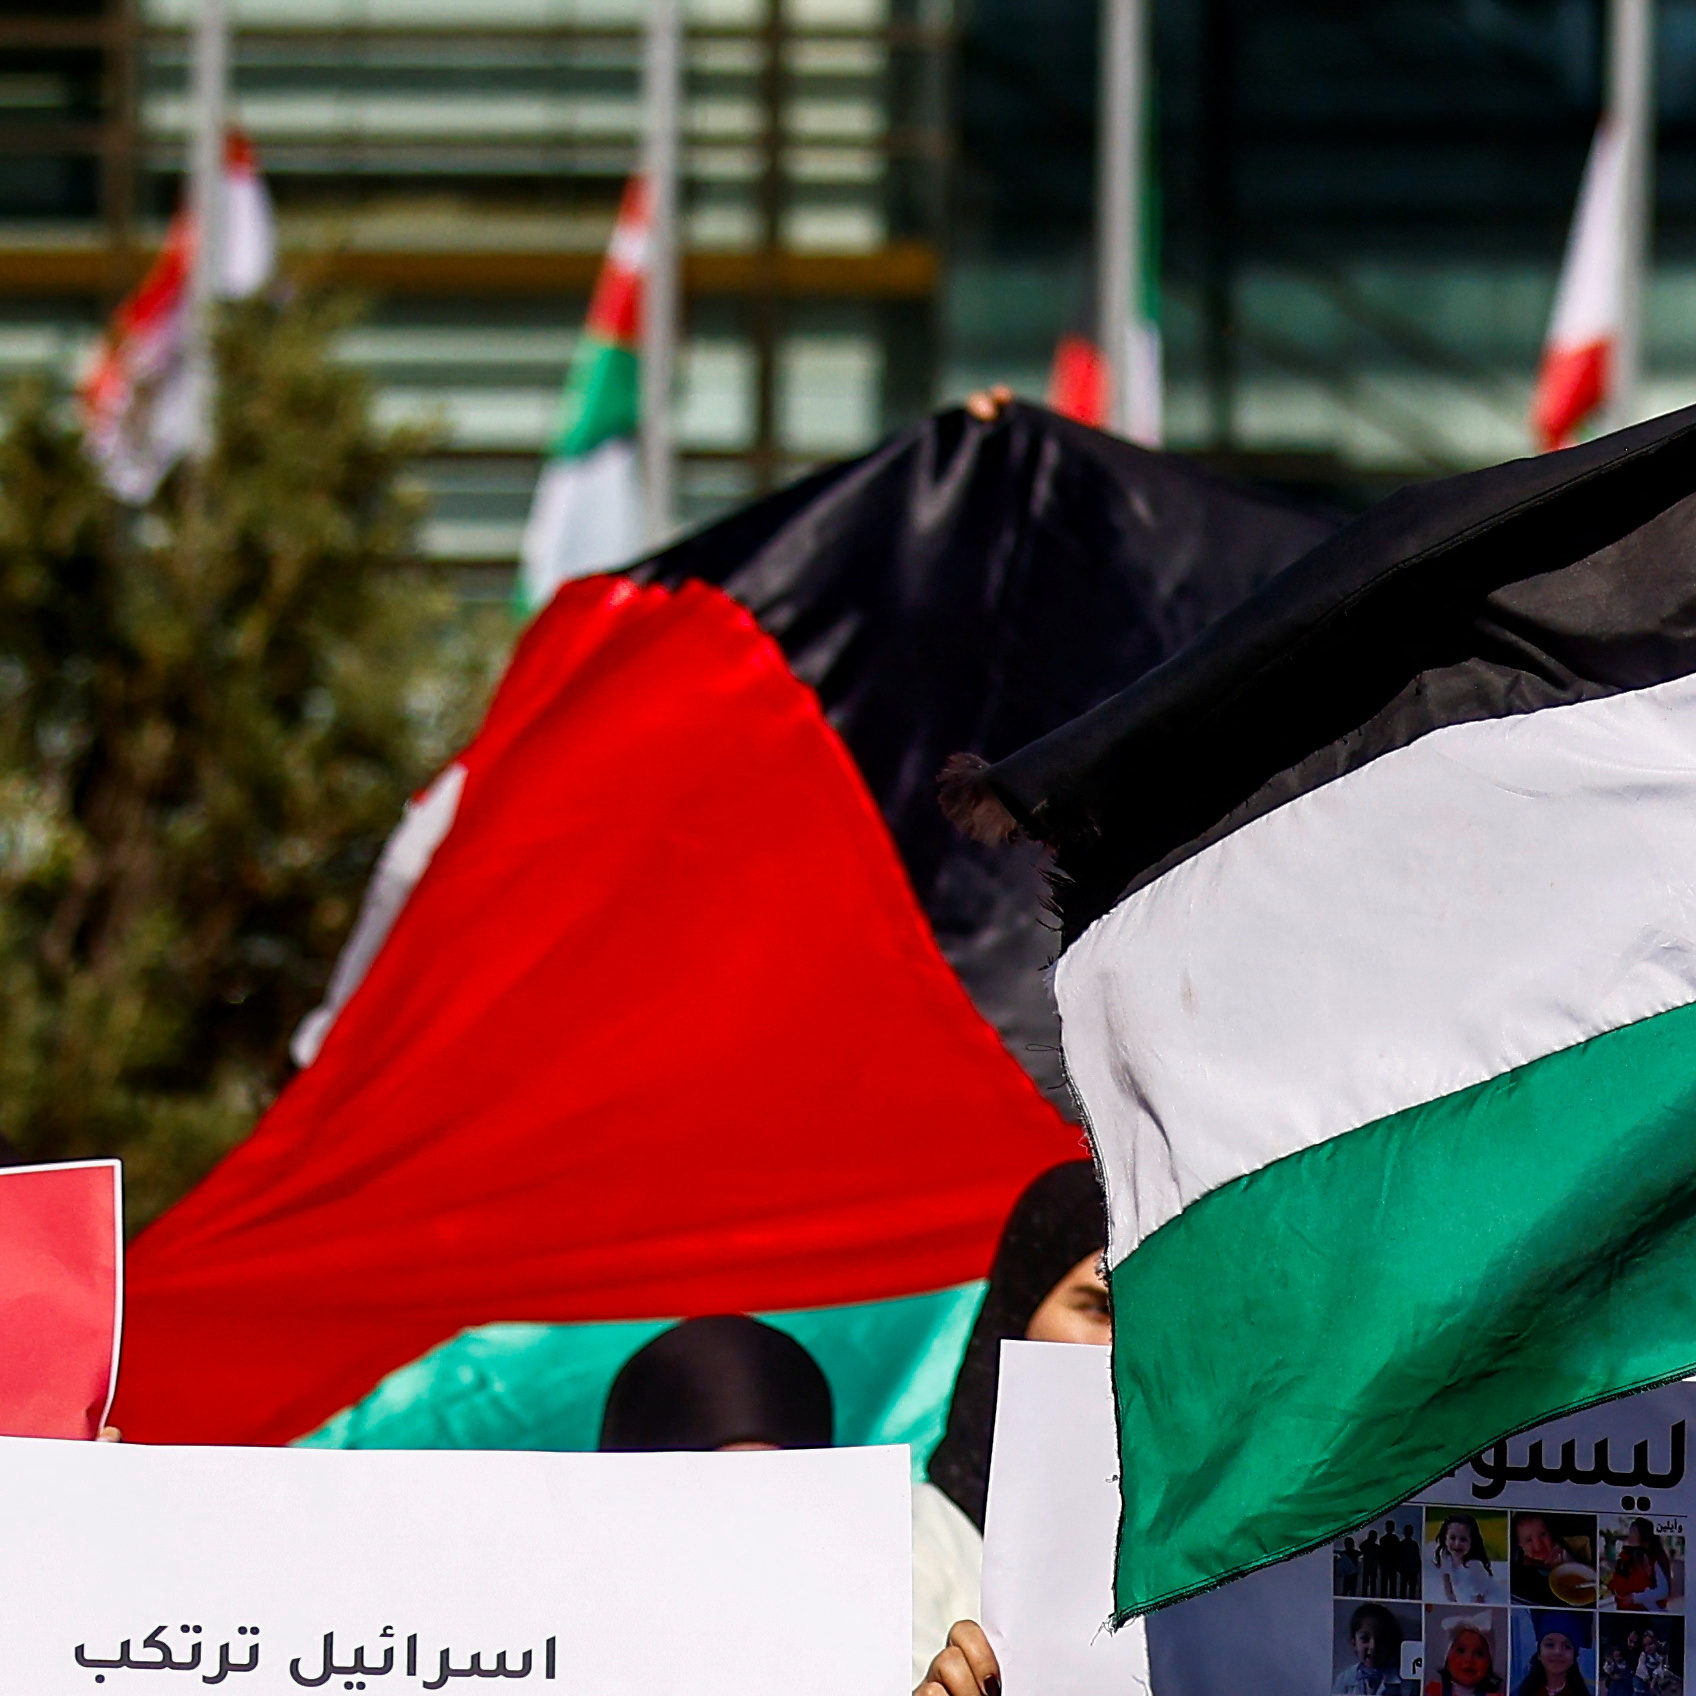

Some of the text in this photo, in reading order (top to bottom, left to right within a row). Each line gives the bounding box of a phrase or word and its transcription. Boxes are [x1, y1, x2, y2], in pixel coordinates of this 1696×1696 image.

[1440, 1418, 1688, 1513] ليسو
[74, 1624, 556, 1691] اسرائيل ترتكب
